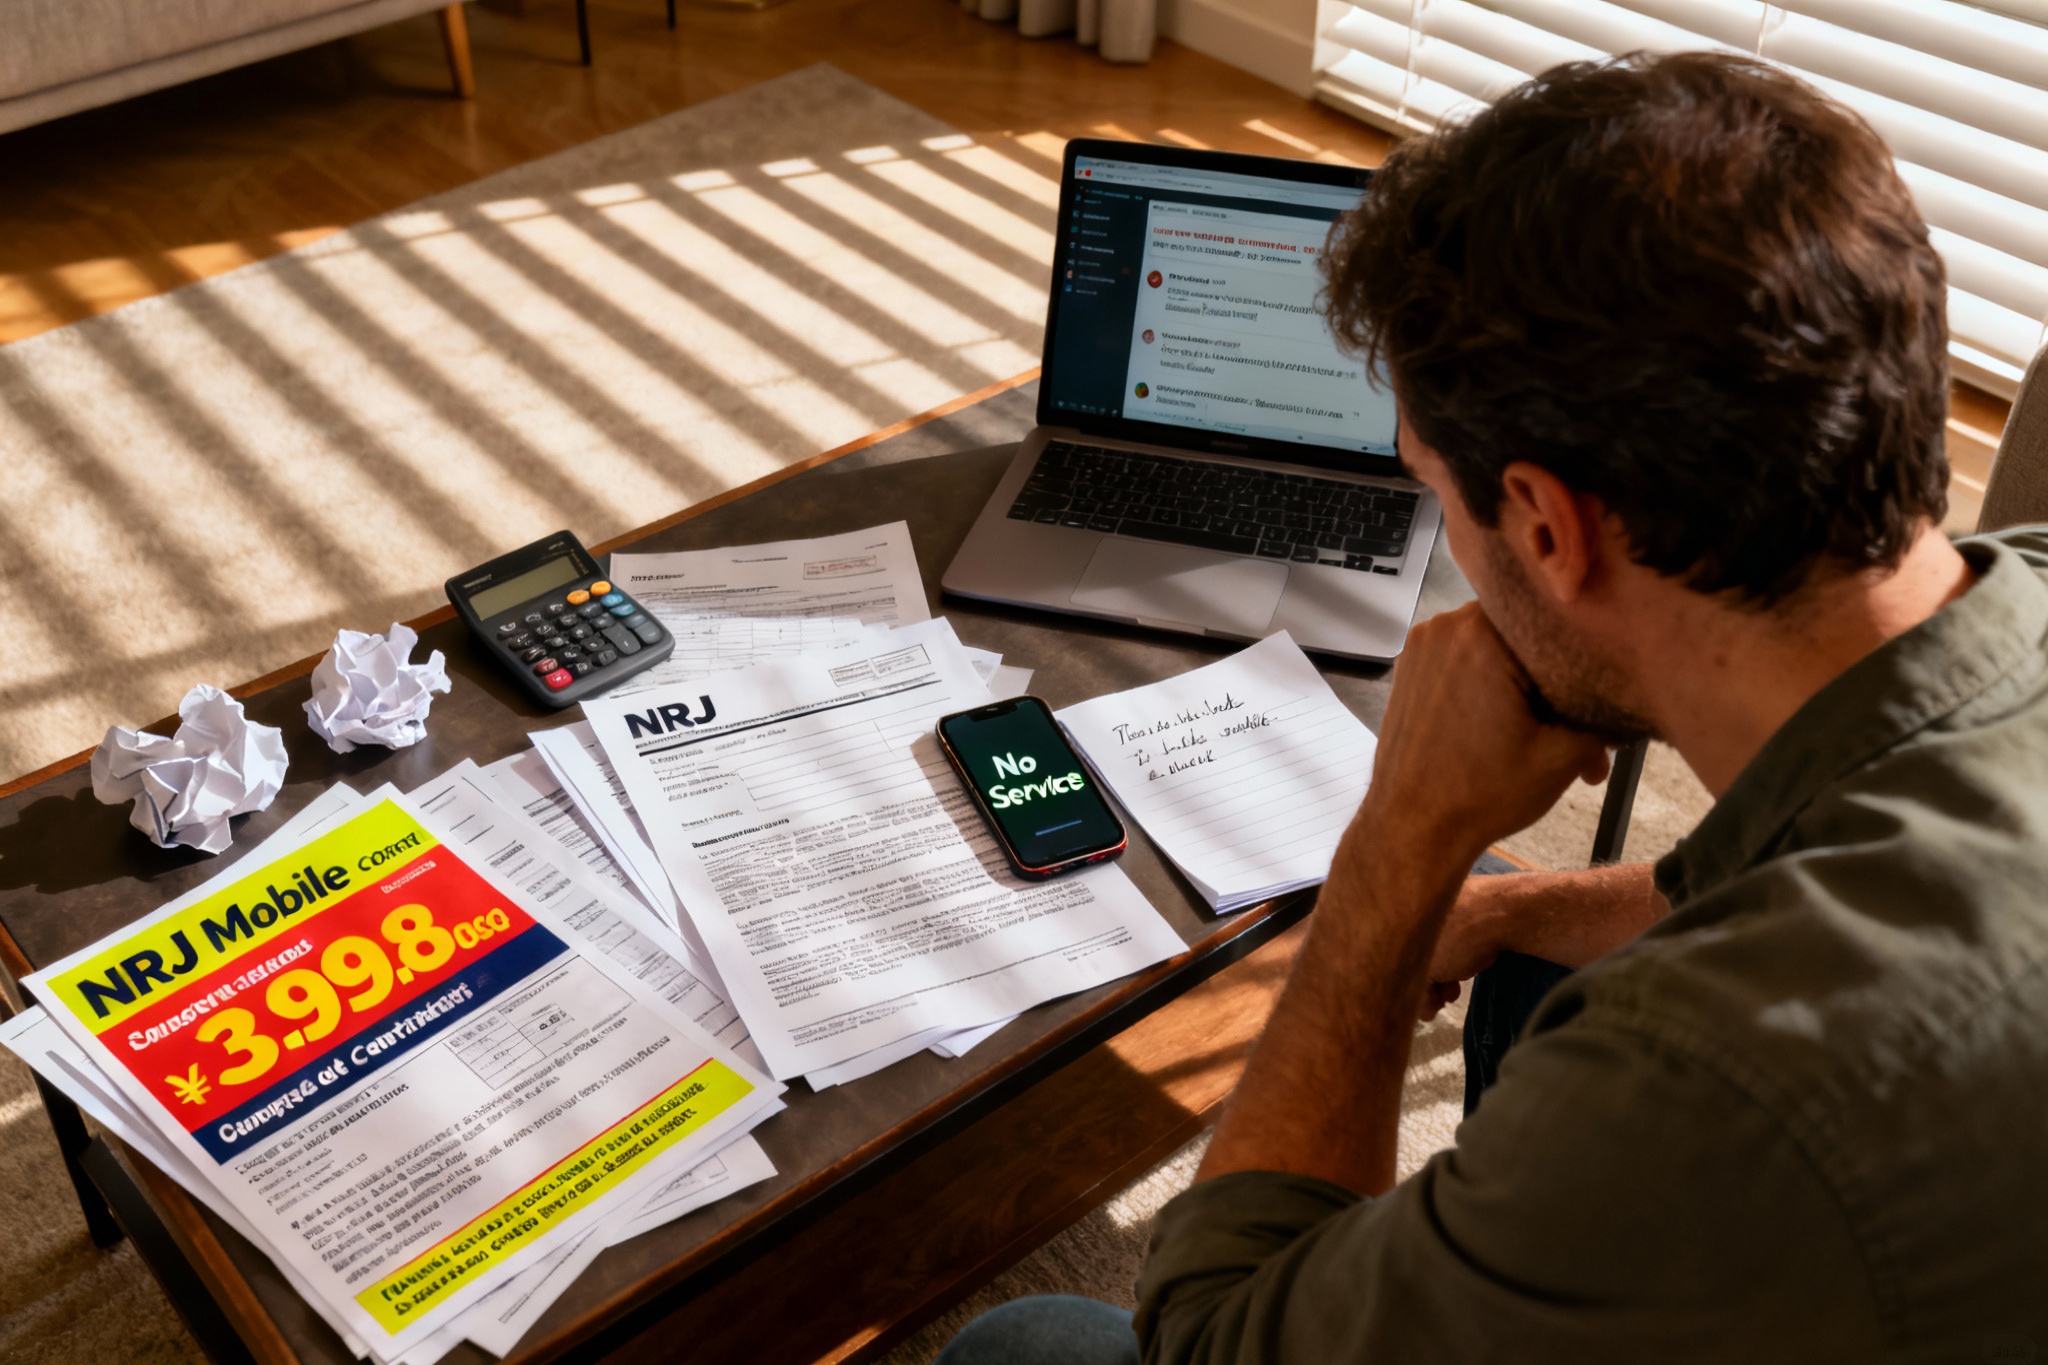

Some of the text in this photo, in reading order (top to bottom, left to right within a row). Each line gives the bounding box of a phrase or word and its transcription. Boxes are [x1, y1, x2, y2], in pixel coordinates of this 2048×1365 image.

[623, 695, 717, 740] NRJ
[991, 751, 1037, 780] No
[988, 771, 1085, 809] Service
[76, 929, 199, 1019] NRJ
[200, 863, 351, 954] Mobile
